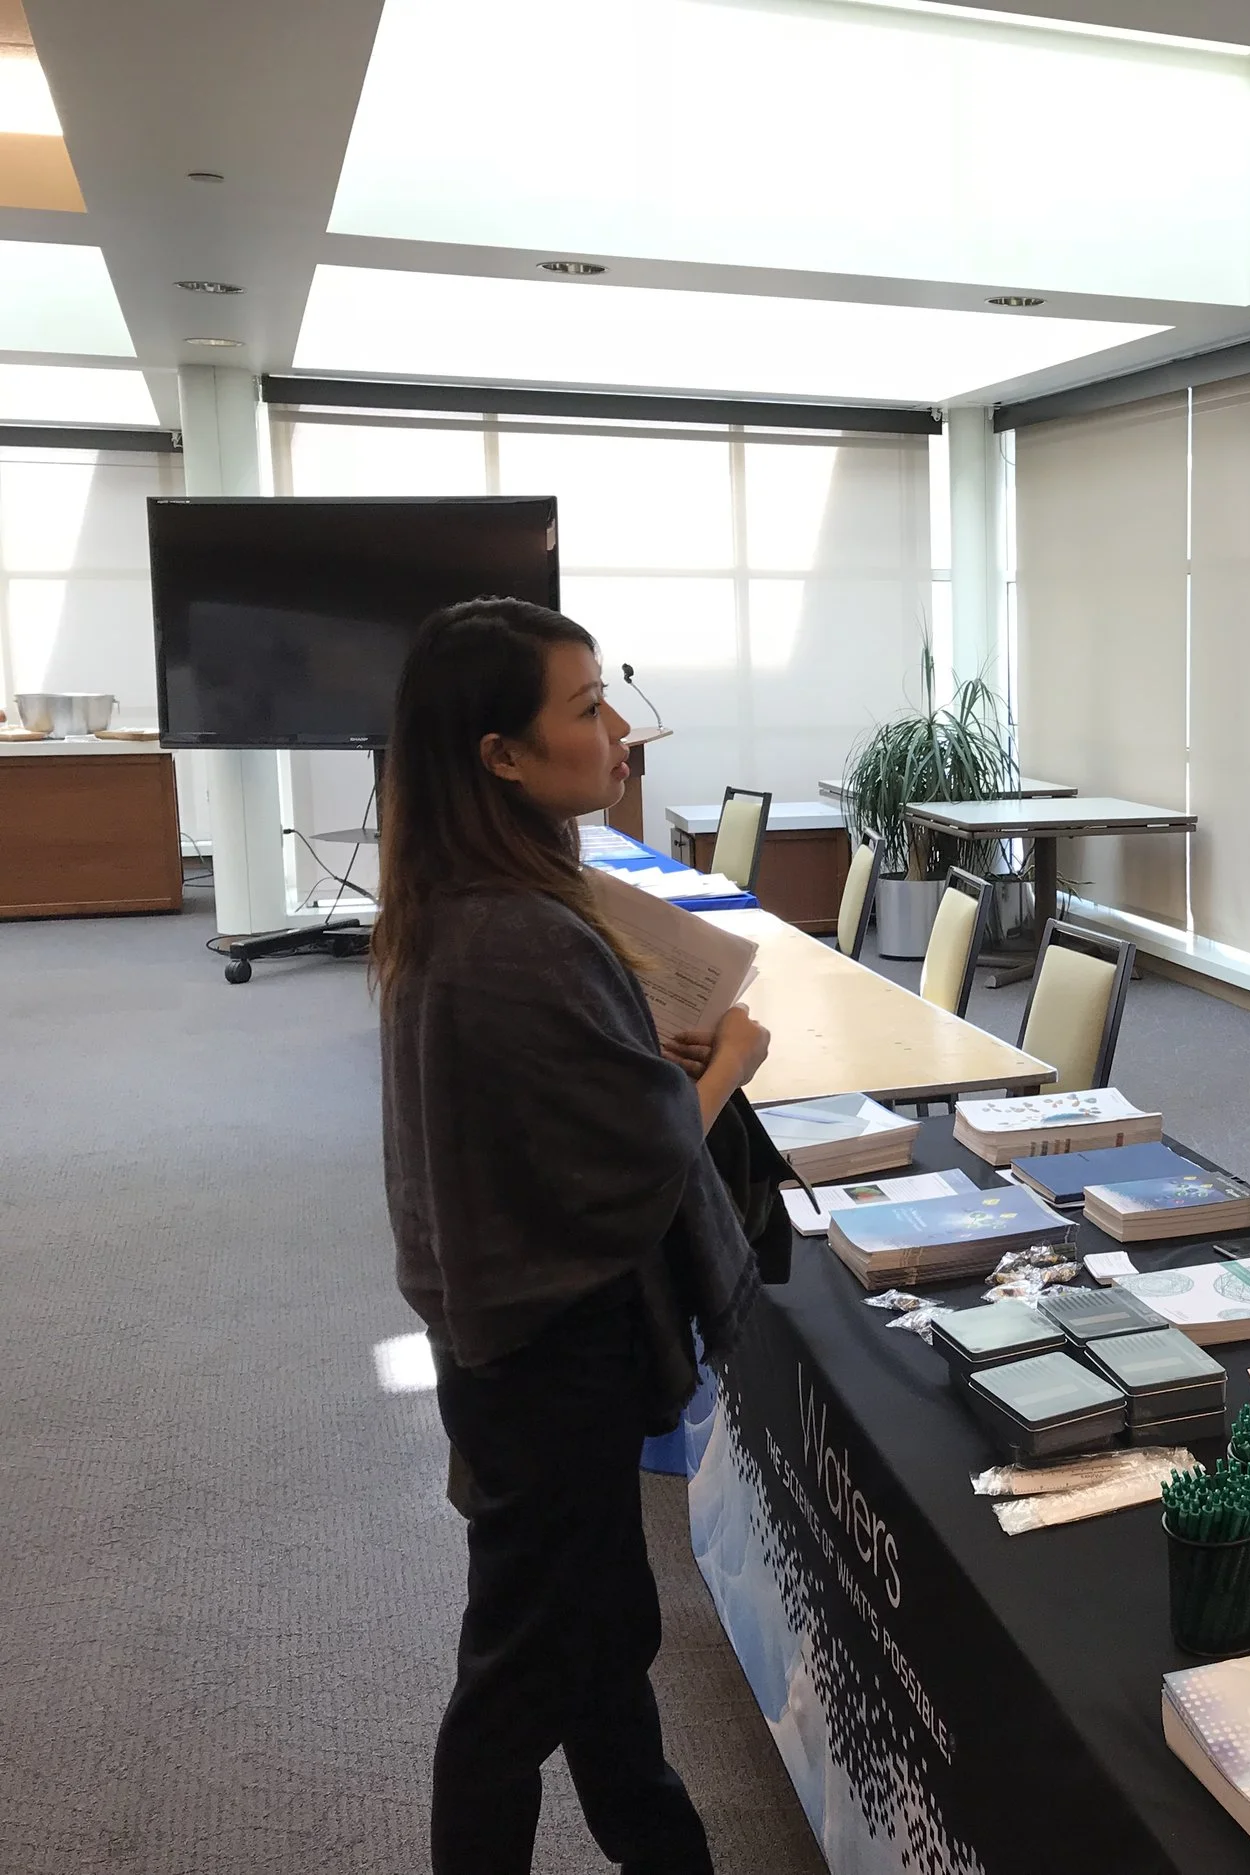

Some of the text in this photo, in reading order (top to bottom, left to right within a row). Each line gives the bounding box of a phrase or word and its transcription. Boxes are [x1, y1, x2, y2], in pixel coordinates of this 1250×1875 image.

[765, 1427, 781, 1475] THE
[784, 1459, 820, 1545] SCIENCE
[821, 1527, 835, 1566] OF
[836, 1556, 879, 1642] WHAT'S
[798, 1361, 900, 1608] Waters
